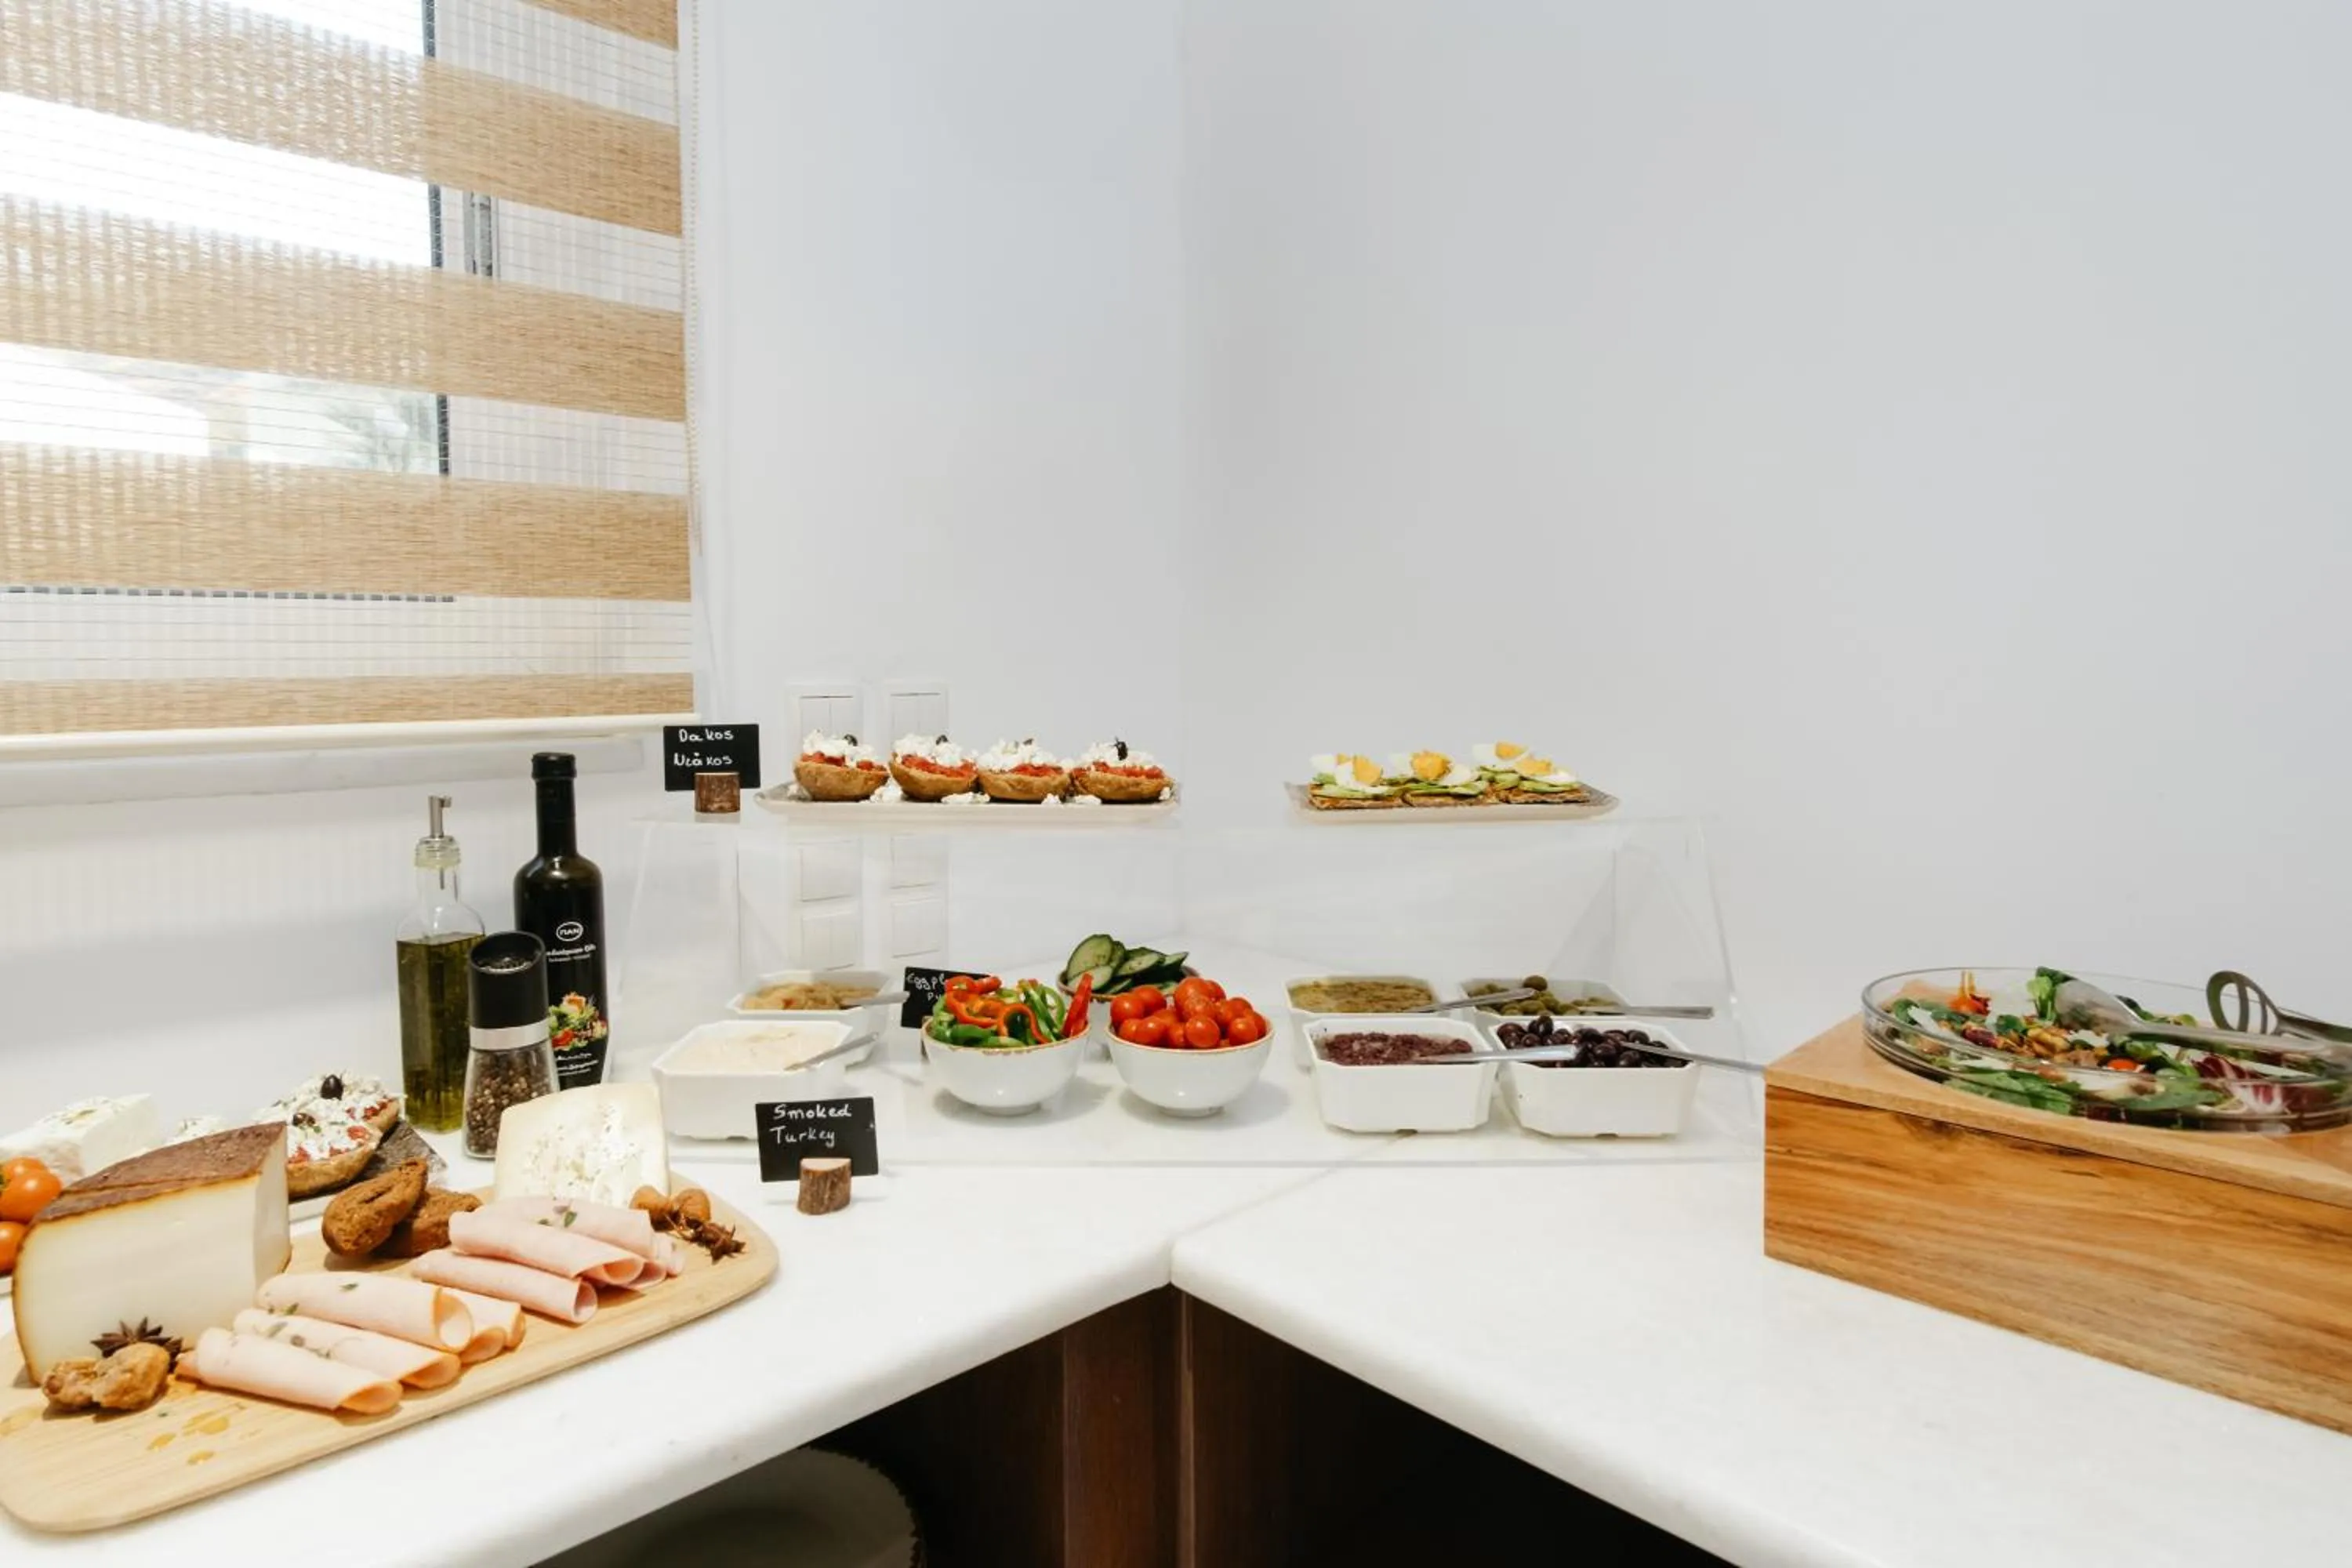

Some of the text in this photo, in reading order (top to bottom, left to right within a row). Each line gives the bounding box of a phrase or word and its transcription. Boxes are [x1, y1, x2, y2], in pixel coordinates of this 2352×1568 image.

[678, 728, 735, 742] Dakos
[907, 972, 945, 990] Eggpl
[772, 1103, 852, 1120] Smoked
[769, 1125, 837, 1149] Turkey
